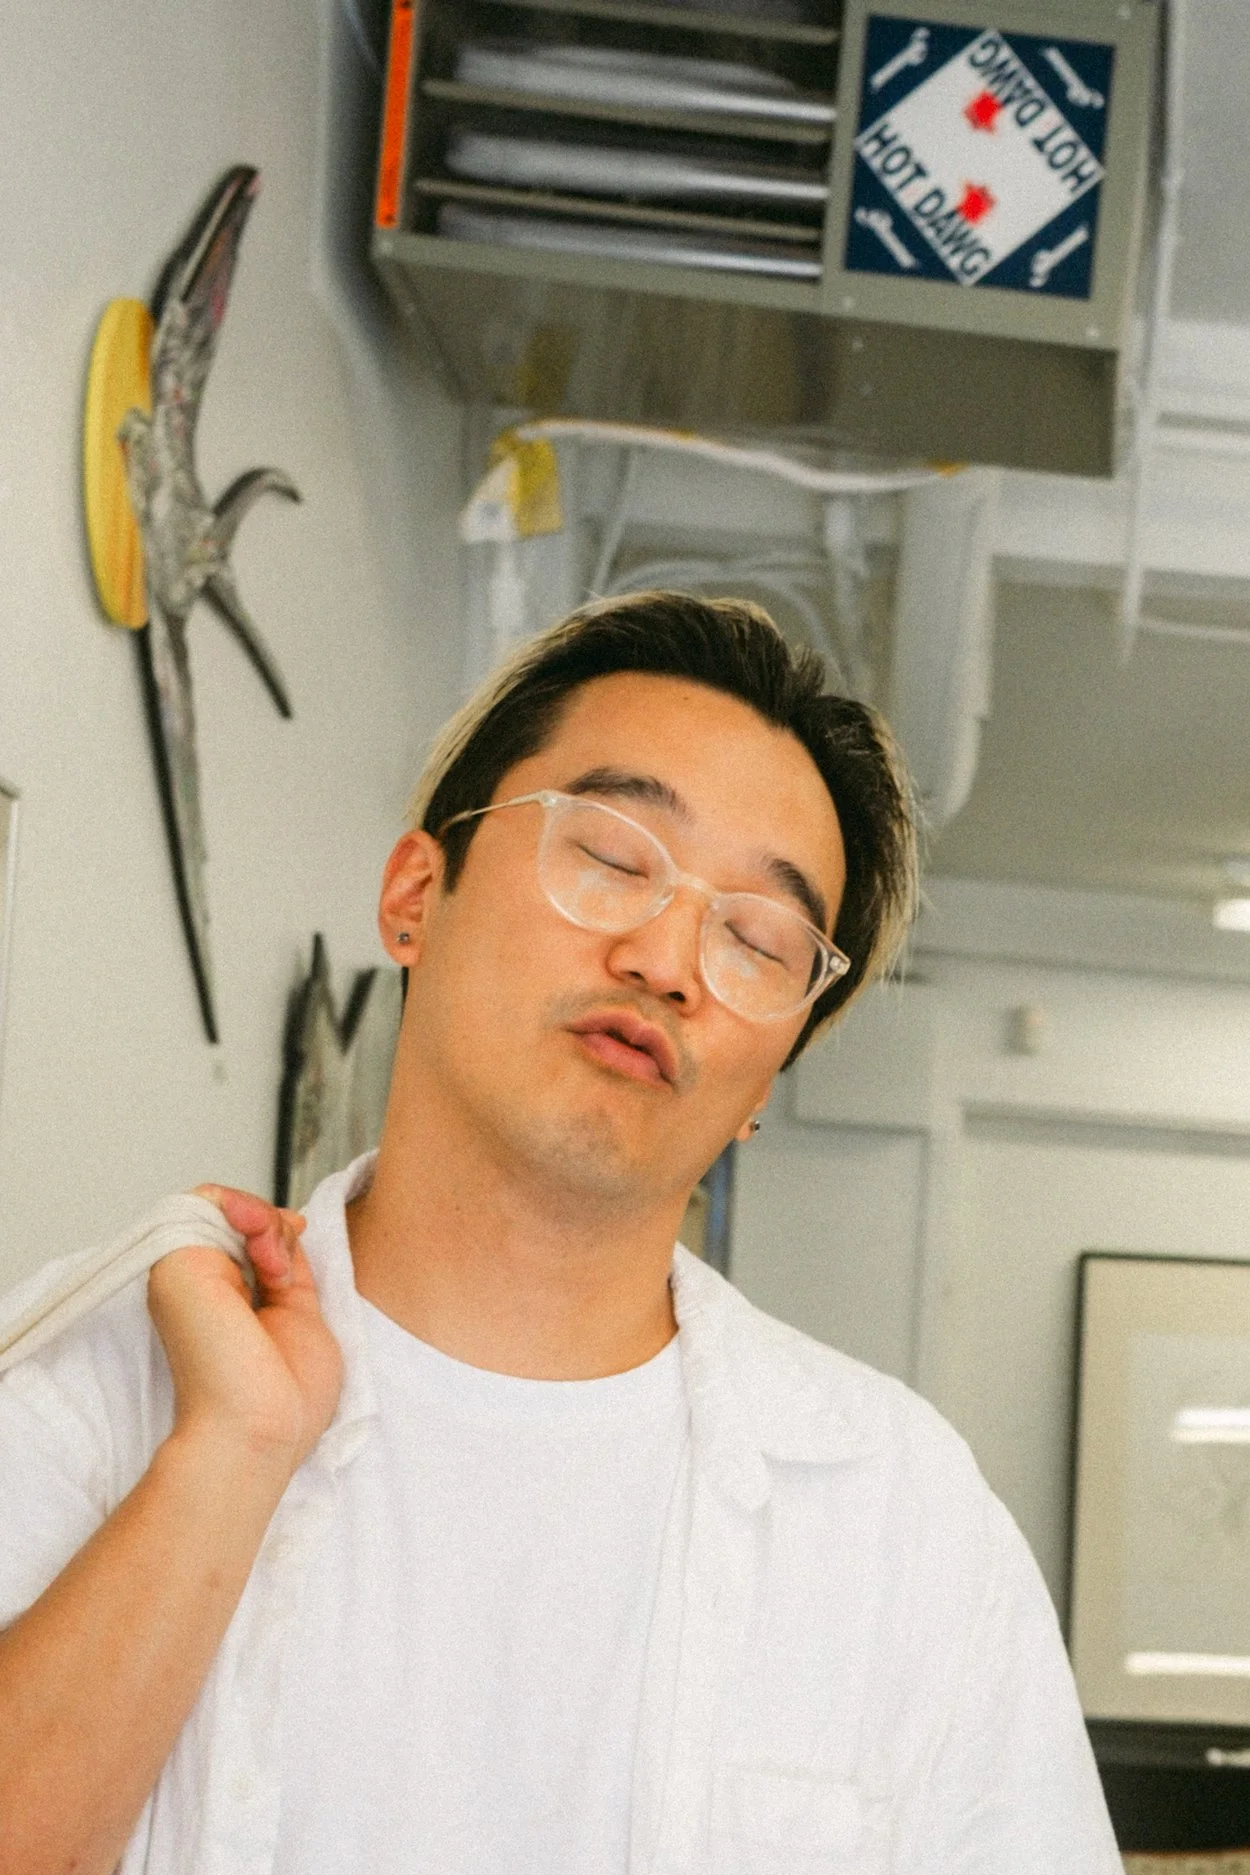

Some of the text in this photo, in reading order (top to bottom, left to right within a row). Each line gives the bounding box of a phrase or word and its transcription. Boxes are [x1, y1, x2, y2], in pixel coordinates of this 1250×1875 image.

[968, 37, 1096, 193] HOT DAWG
[864, 124, 991, 276] HOT DAWG
